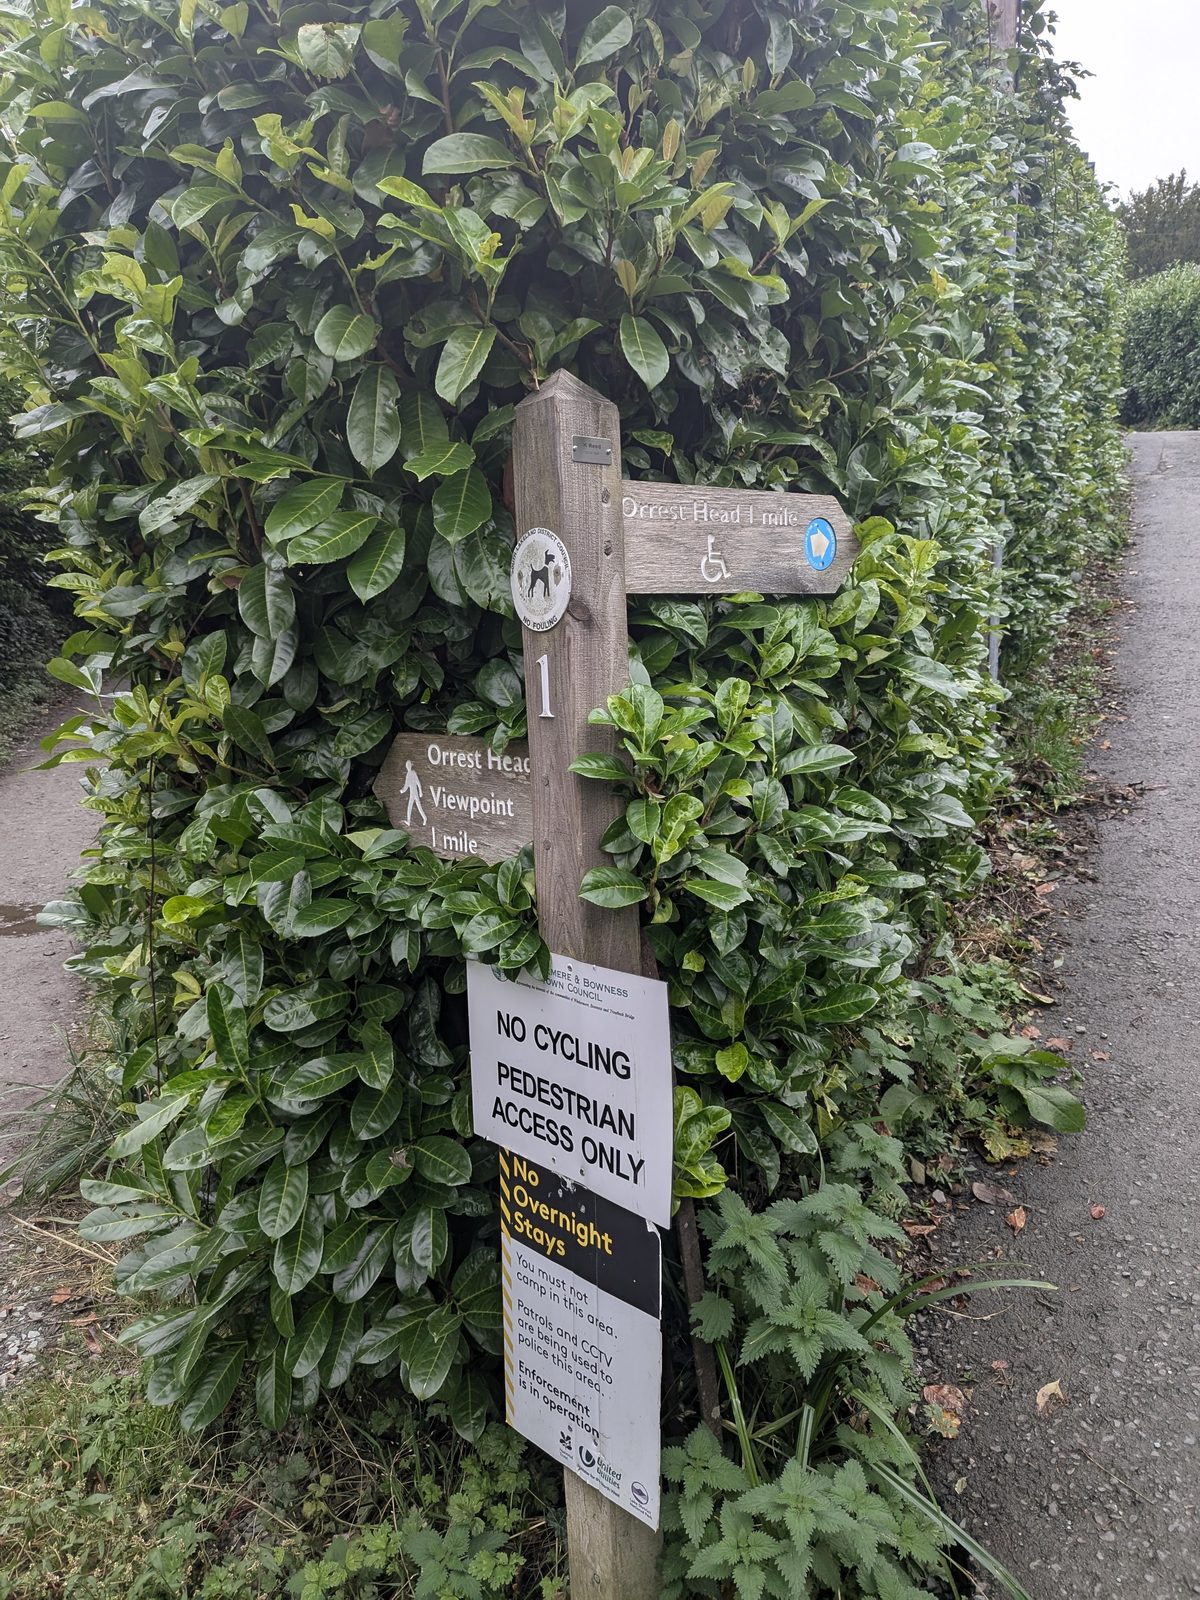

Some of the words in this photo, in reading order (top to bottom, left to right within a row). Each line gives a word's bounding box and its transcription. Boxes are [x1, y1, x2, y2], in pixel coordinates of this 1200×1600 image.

[622, 497, 687, 520] Orrest
[694, 500, 740, 524] Head
[762, 508, 798, 526] mile
[538, 528, 558, 542] DISTRICT
[556, 542, 569, 570] COUNCIL
[522, 616, 530, 626] NO
[532, 615, 558, 630] FOULING
[536, 654, 555, 718] 1
[427, 744, 482, 769] Orrest
[430, 785, 514, 818] Viewpoint
[443, 830, 478, 854] mile
[544, 978, 564, 990] OWN
[568, 982, 602, 1002] COUNCIL
[574, 974, 580, 984] &
[583, 978, 628, 998] BOWNESS
[496, 1010, 526, 1042] NO
[534, 1024, 631, 1080] CYCLING
[497, 1061, 635, 1141] PEDESTRIAN
[492, 1096, 574, 1152] ACCESS
[581, 1136, 645, 1185] ONLY
[514, 1156, 540, 1186] No
[514, 1185, 613, 1256] Overnight
[514, 1210, 566, 1256] Stays
[516, 1252, 534, 1272] You
[538, 1268, 566, 1292] must
[570, 1286, 588, 1305] not
[516, 1271, 546, 1297] camp
[550, 1288, 560, 1304] in
[564, 1294, 584, 1318] this
[588, 1314, 618, 1339] area.
[518, 1299, 553, 1332] Patrols
[556, 1326, 578, 1346] and
[581, 1340, 613, 1368] CCTV
[518, 1318, 534, 1334] are
[538, 1327, 568, 1358] being
[572, 1350, 598, 1374] used
[600, 1369, 613, 1384] to
[518, 1333, 549, 1359] police
[552, 1352, 572, 1374] this
[576, 1371, 604, 1397] area.
[518, 1375, 526, 1390] is
[530, 1383, 540, 1399] in
[518, 1360, 590, 1418] Enforcement
[597, 1456, 622, 1480] United
